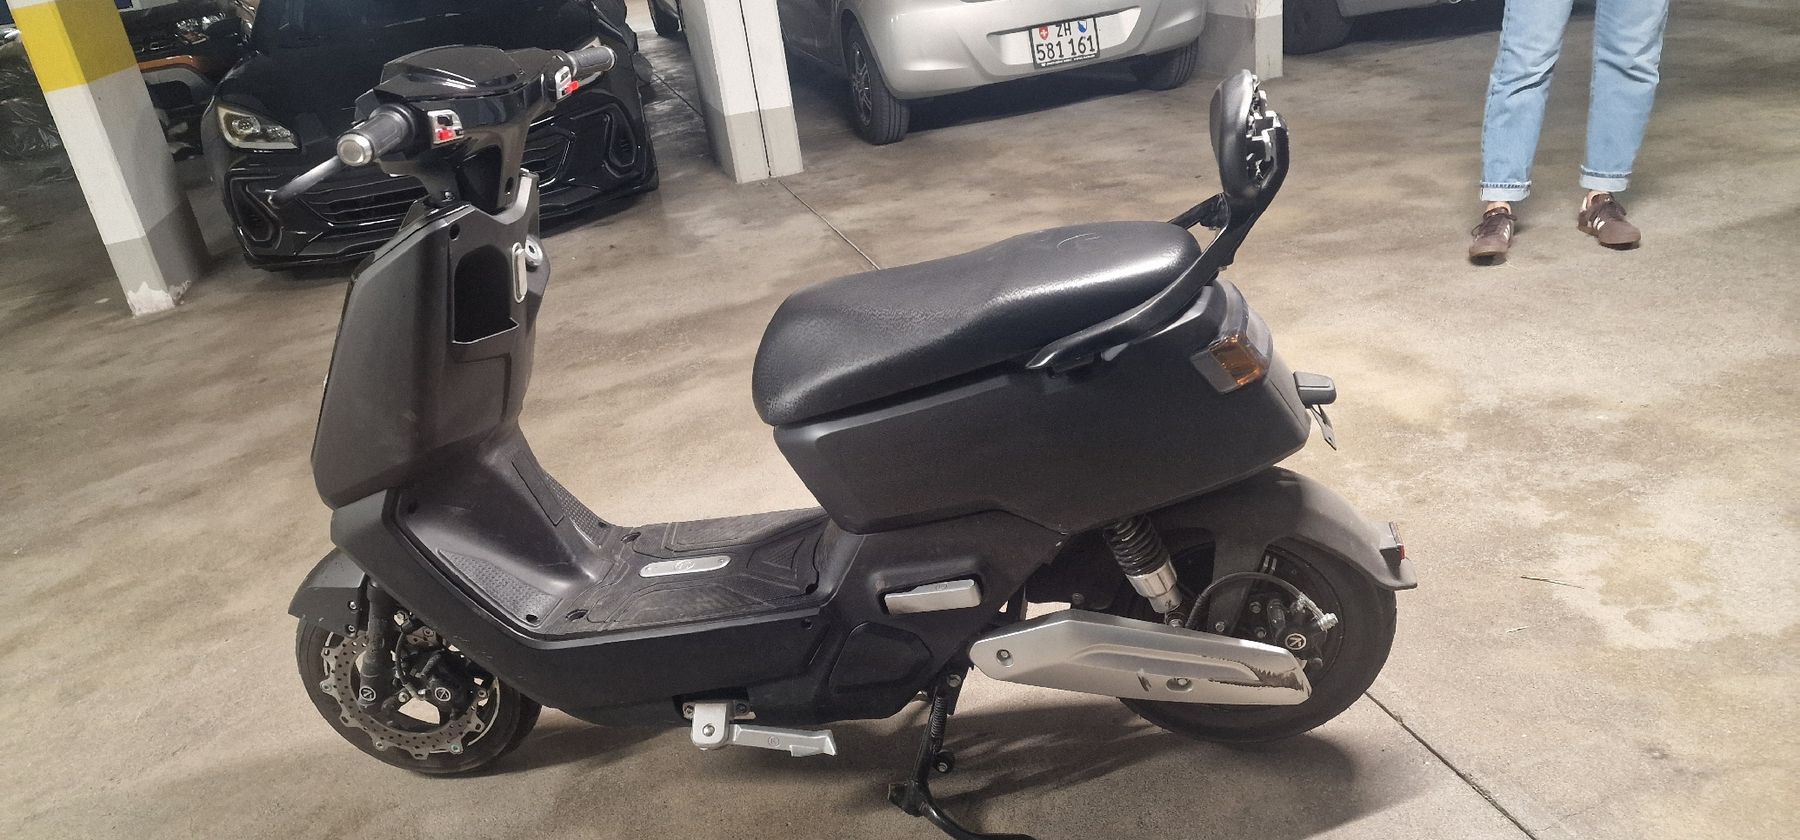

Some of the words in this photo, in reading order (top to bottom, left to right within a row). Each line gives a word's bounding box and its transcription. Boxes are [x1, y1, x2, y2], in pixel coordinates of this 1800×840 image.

[1055, 22, 1072, 38] ZH
[1036, 41, 1064, 61] 581
[1068, 35, 1095, 55] 161
